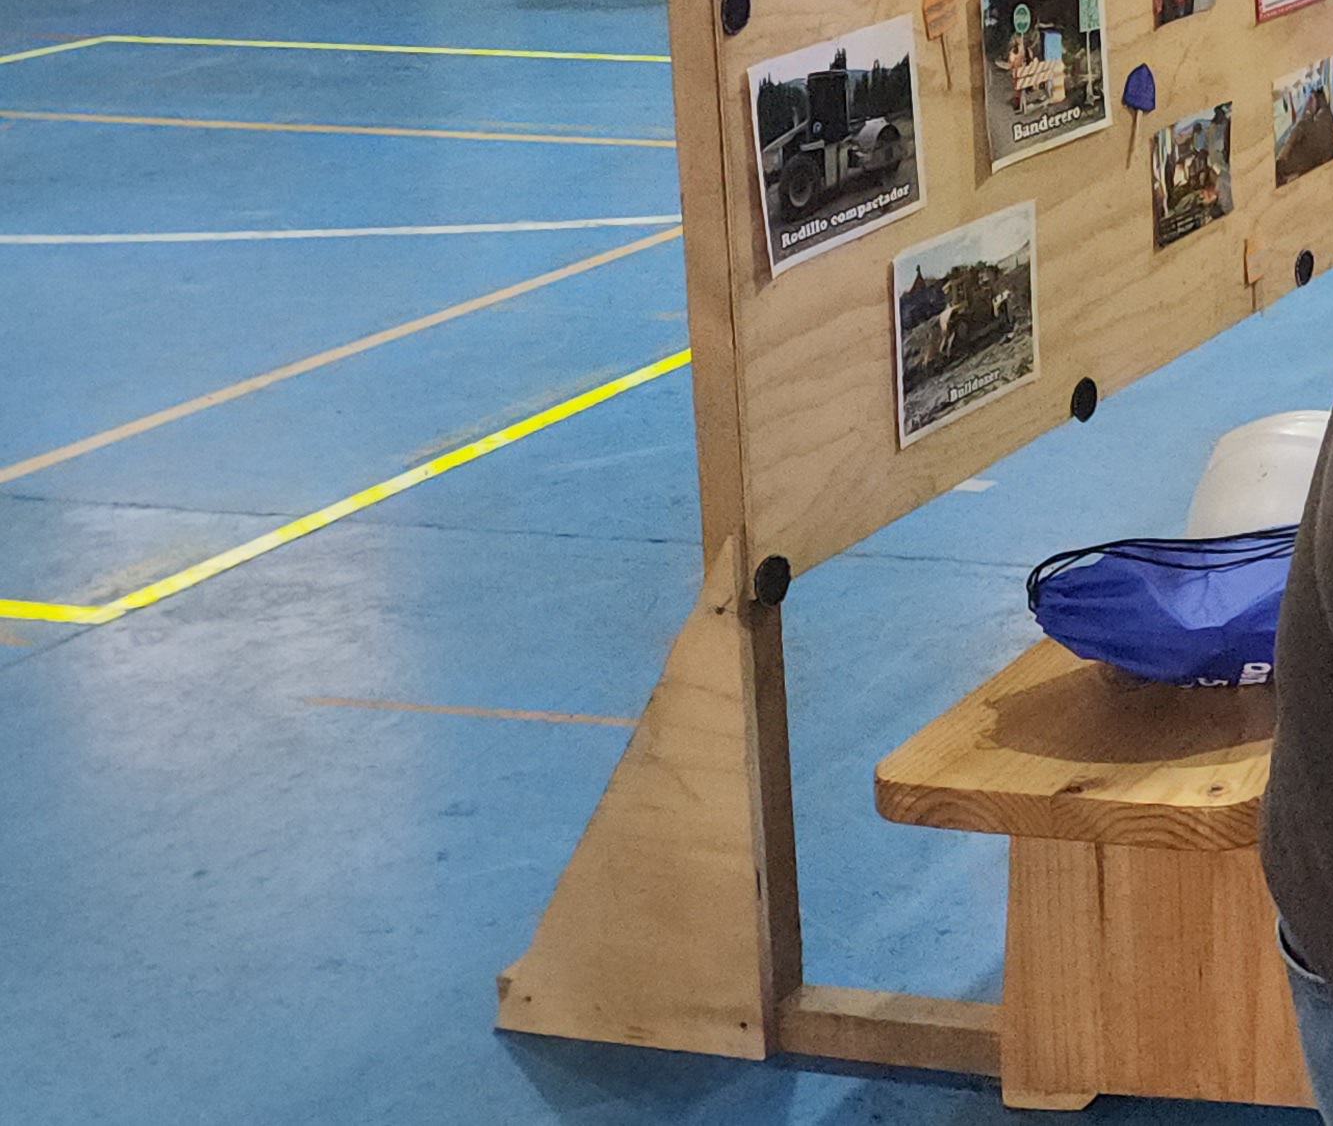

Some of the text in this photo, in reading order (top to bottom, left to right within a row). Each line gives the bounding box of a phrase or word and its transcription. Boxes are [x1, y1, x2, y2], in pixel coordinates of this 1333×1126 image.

[1013, 105, 1081, 142] Banderero
[781, 184, 910, 249] Rodillo compactador
